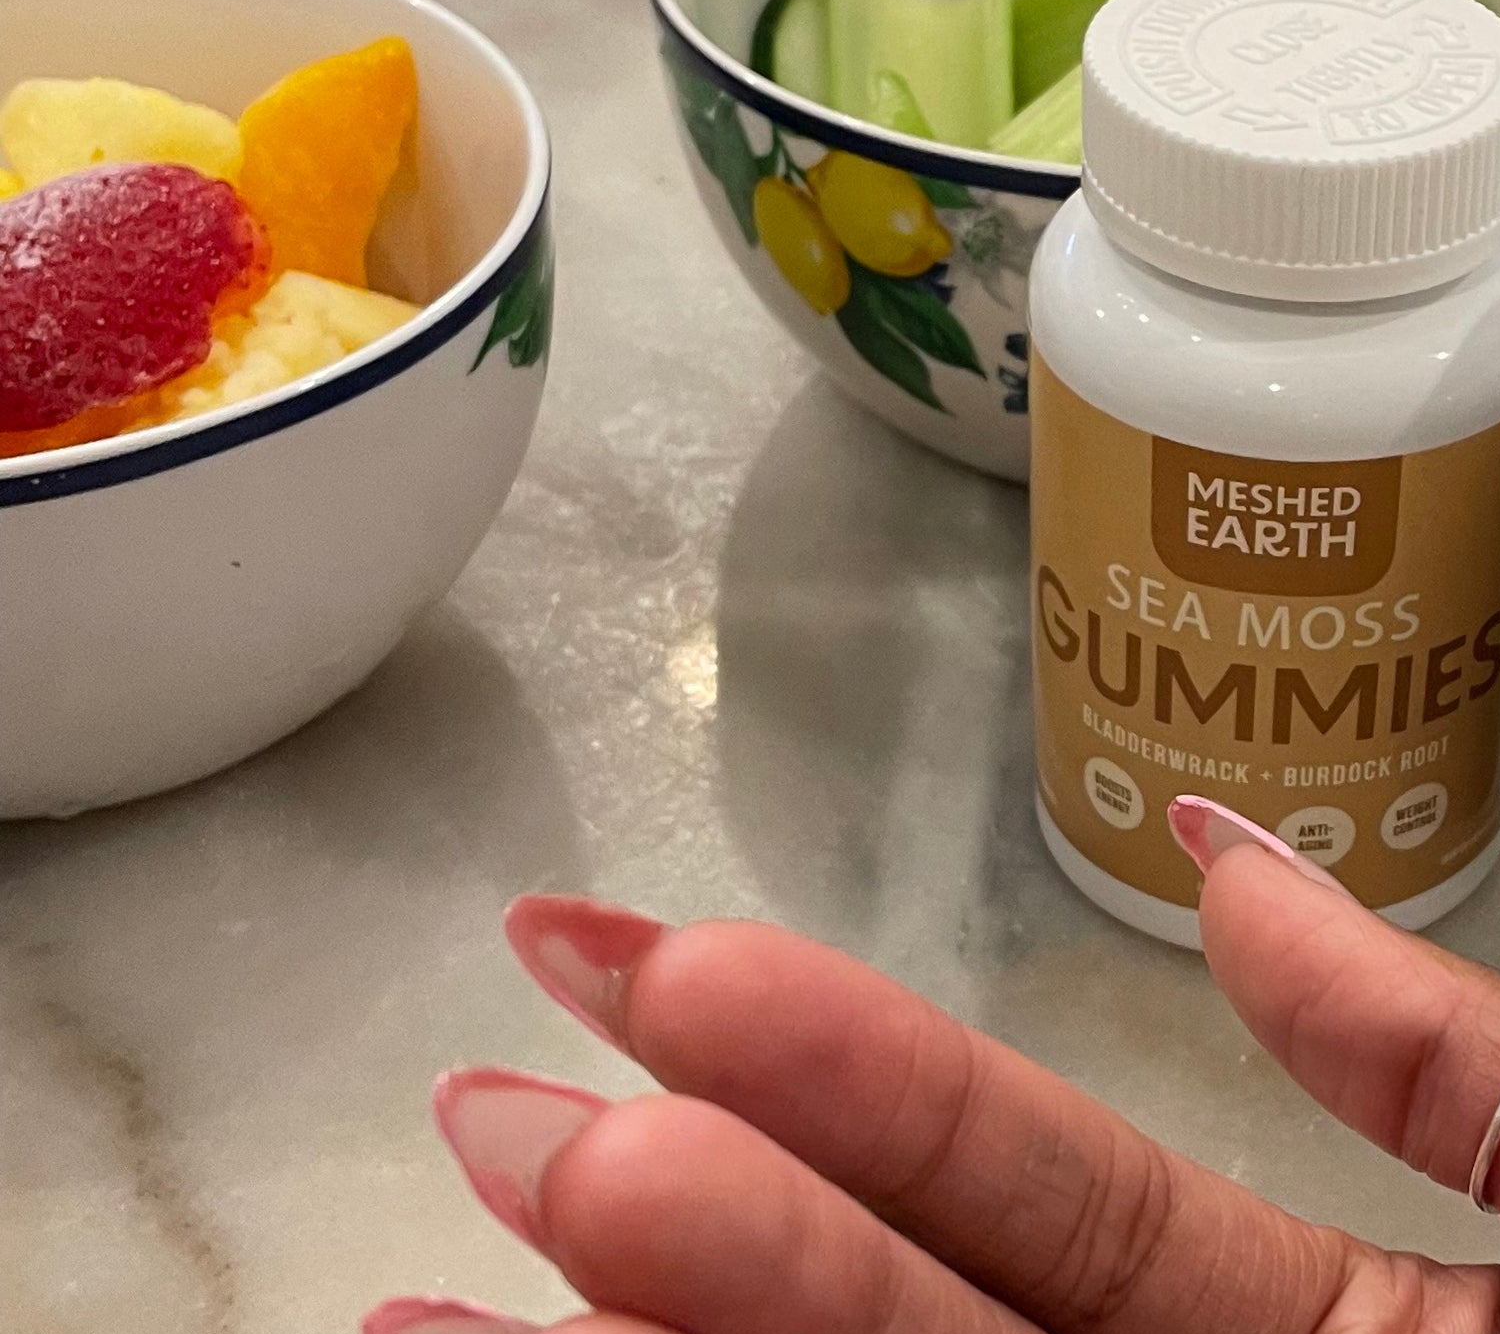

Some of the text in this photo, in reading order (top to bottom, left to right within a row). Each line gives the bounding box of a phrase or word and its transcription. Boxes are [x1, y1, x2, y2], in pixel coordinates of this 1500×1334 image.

[1186, 470, 1361, 518] MESHED
[1186, 506, 1357, 559] EARTH
[1106, 563, 1421, 651] SEA MOSS
[1082, 703, 1249, 784] BLADDERWRACK
[1284, 756, 1393, 788] BURDOCK
[1399, 735, 1450, 773] ROOT
